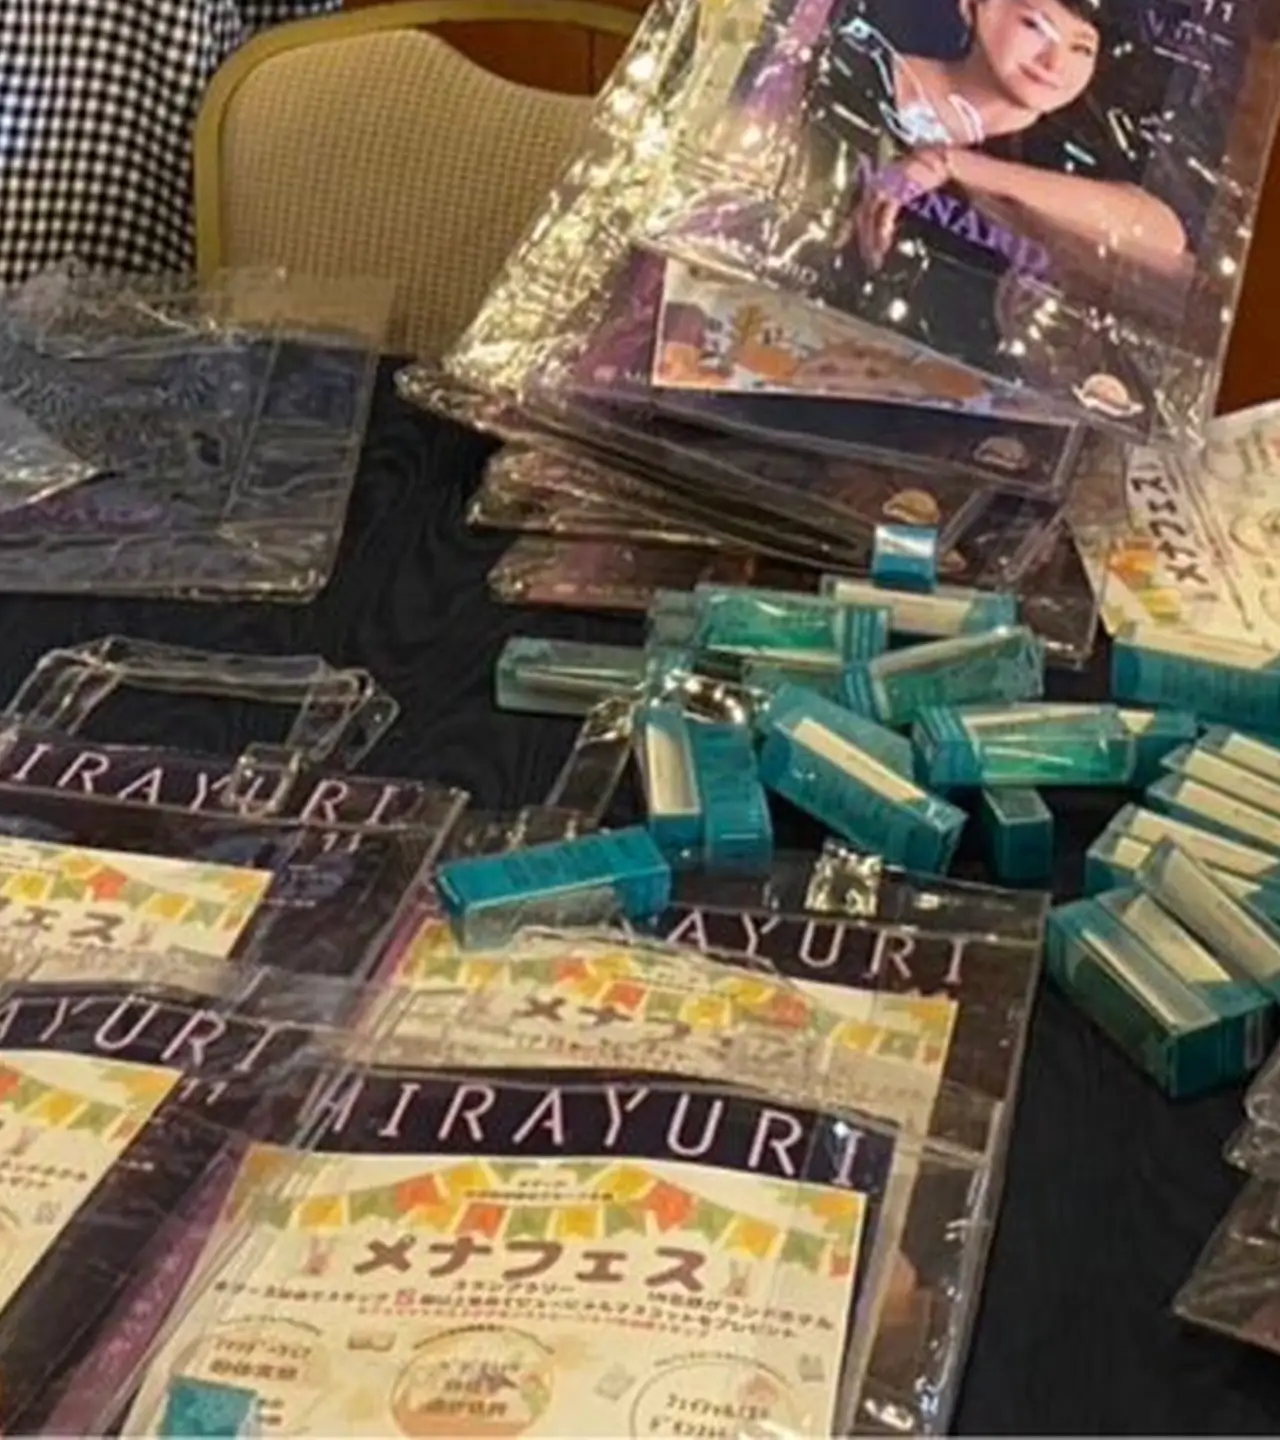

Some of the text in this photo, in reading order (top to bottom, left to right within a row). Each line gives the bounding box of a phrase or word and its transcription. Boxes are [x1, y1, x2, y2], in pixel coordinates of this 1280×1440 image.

[353, 1234, 706, 1292] メナフェス
